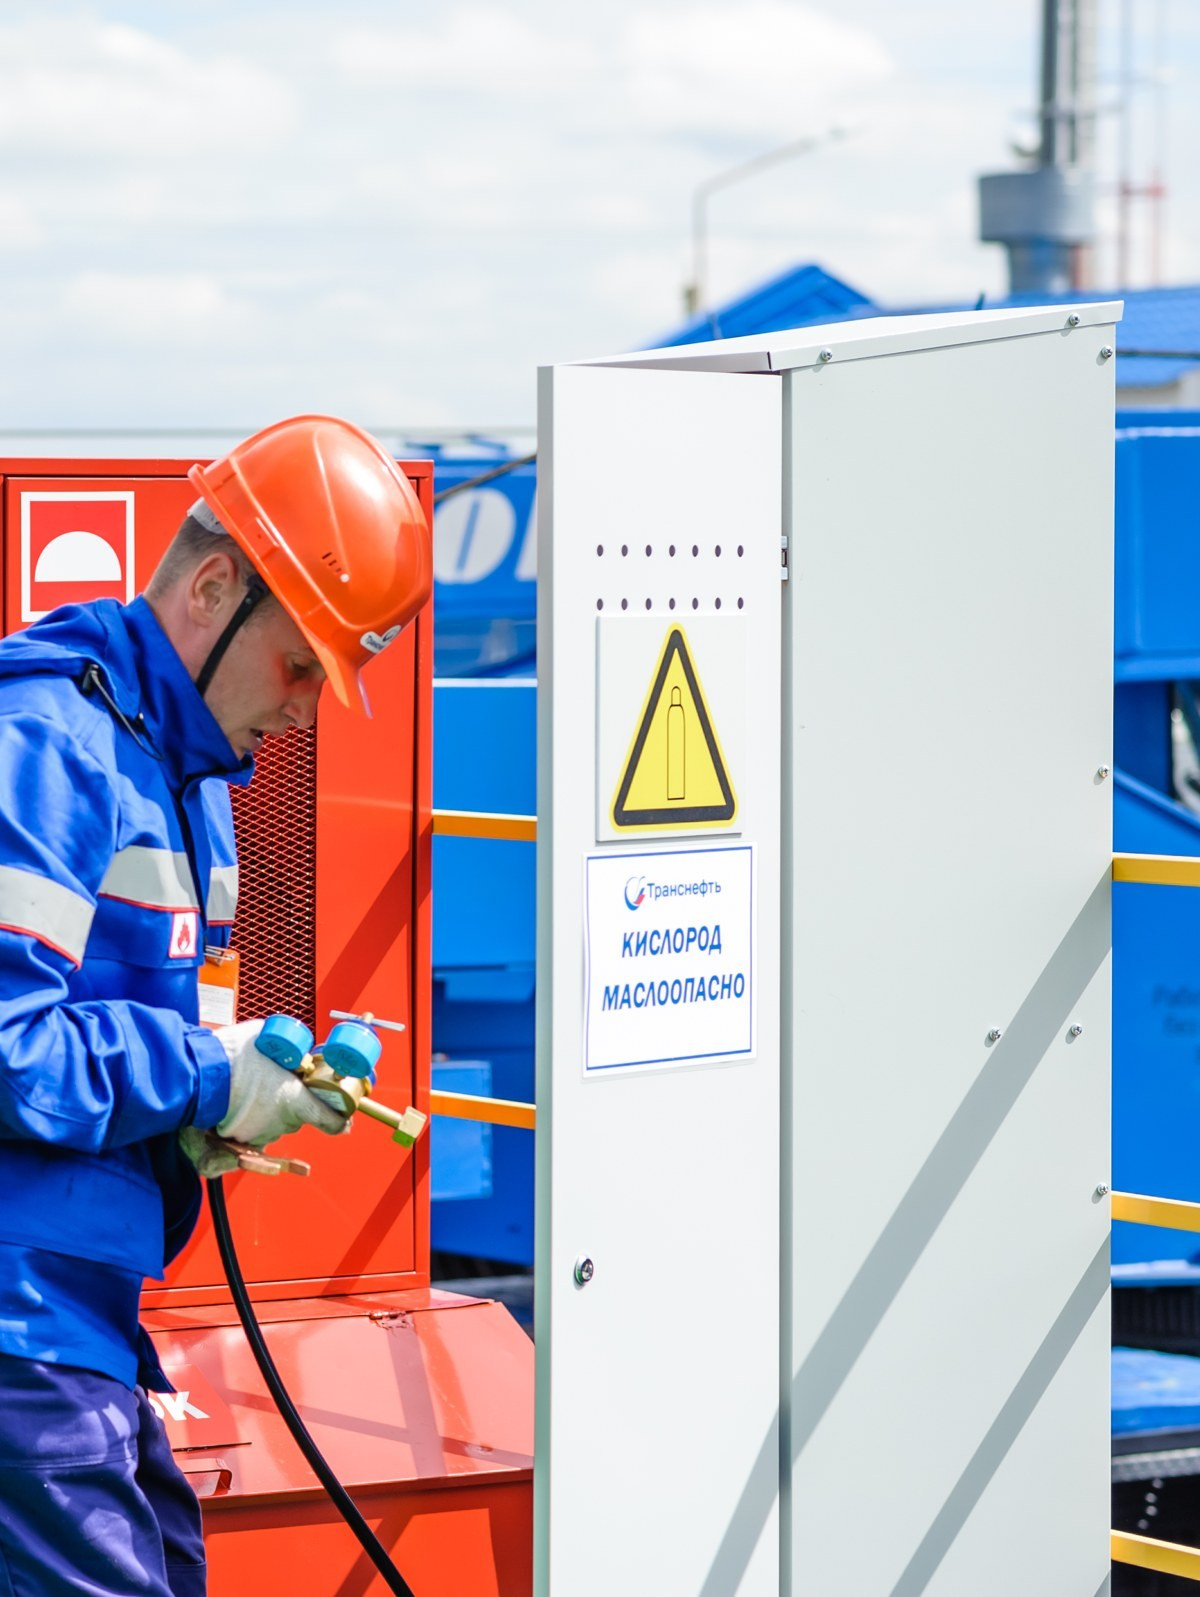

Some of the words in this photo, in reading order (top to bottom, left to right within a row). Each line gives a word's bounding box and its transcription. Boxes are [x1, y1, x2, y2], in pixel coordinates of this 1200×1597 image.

[647, 879, 721, 900] Транснефть
[622, 925, 722, 958] КИСЛОРОД
[602, 973, 745, 1012] МАСЛООПАСНО
